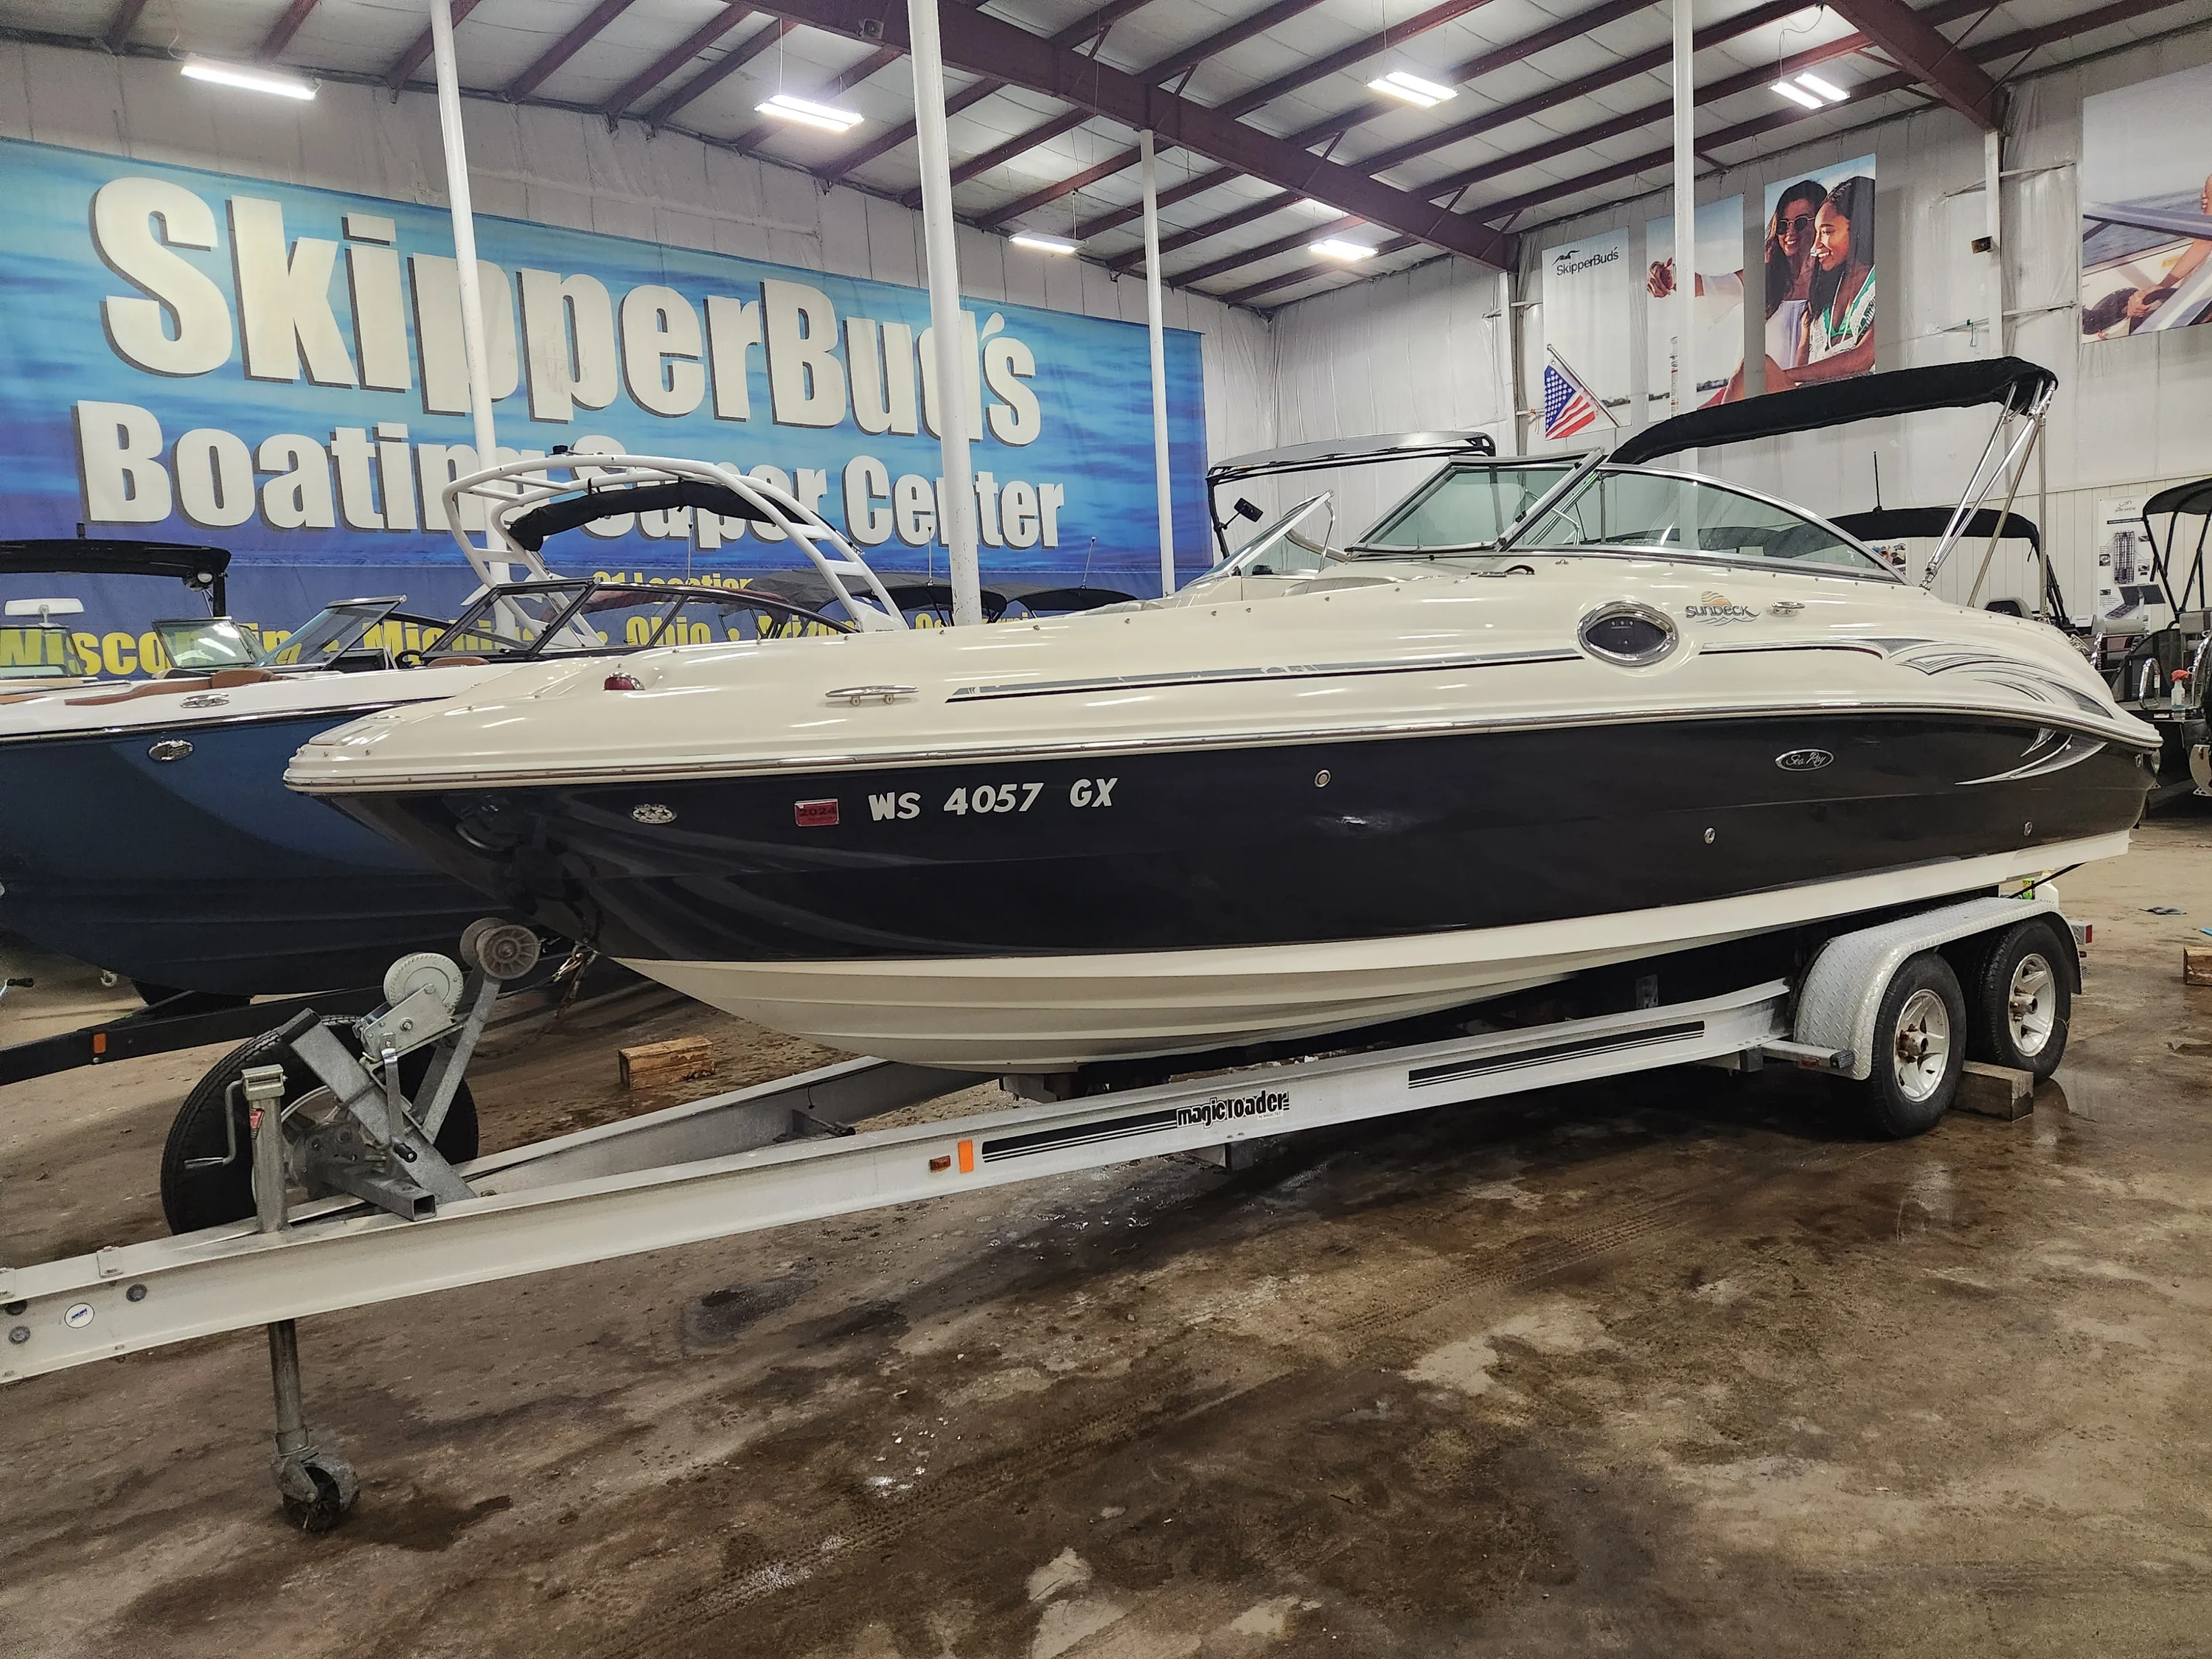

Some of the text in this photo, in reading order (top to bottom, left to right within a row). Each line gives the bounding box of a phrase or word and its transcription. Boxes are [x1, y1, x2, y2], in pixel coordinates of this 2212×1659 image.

[841, 454, 1065, 549] Ceter
[1785, 752, 1827, 767] Sea Ray
[868, 777, 1119, 821] WS 4057 GX
